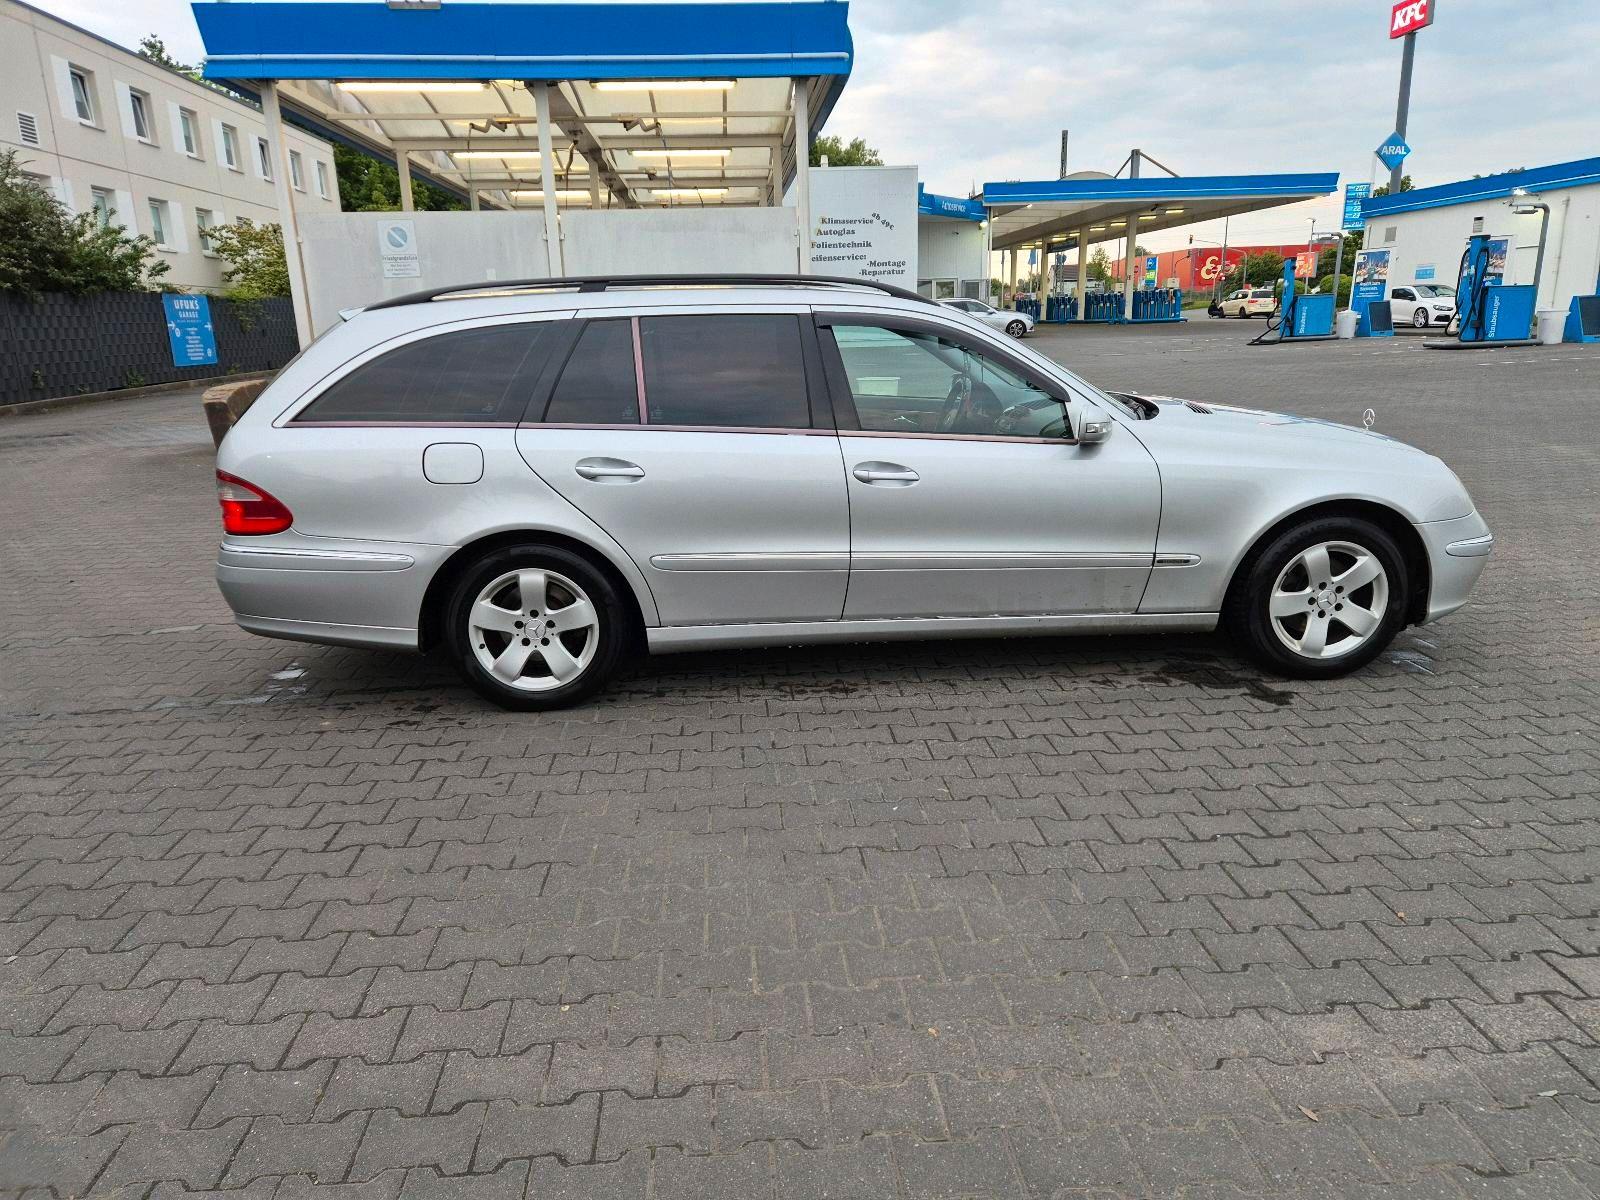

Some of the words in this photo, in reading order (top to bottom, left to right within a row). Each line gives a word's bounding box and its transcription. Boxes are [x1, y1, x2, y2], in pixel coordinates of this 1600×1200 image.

[1392, 0, 1427, 31] KFC
[1380, 145, 1407, 155] ARAL
[821, 217, 874, 225] Klimaservice
[816, 228, 856, 236] Autoglas
[811, 241, 873, 249] Folientechnik
[811, 253, 867, 262] eifenservice:
[174, 299, 200, 310] UFUKS
